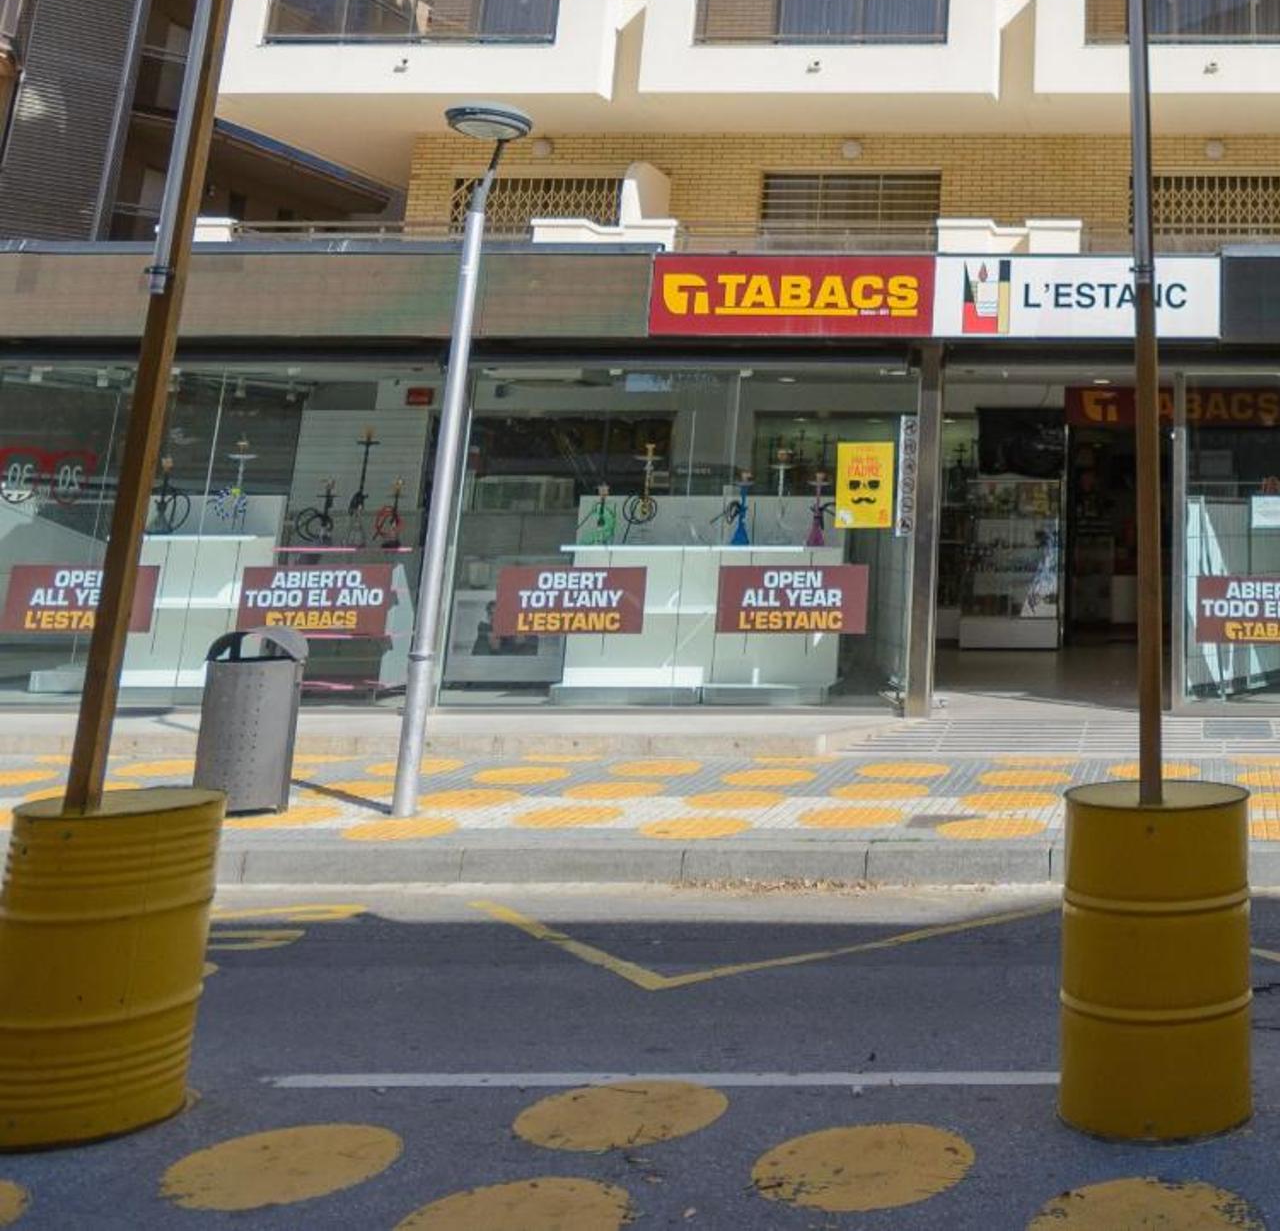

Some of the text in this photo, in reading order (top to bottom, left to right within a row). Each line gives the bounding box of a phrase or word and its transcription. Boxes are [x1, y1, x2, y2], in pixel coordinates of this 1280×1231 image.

[717, 274, 919, 309] TABACS
[1135, 391, 1280, 420] ABACS
[54, 570, 103, 588] OPE
[271, 570, 362, 589] ABIERTO
[538, 572, 608, 589] OBERT
[763, 571, 823, 588] OPEN
[30, 588, 100, 606] ALL YE
[245, 589, 303, 607] TODO
[307, 589, 332, 607] EL
[518, 590, 624, 607] TOT L'ANY
[741, 589, 842, 607] ALL YEAR
[1201, 599, 1260, 617] TODO
[24, 610, 95, 629] L'ESTA
[283, 611, 358, 626] TABACS
[516, 612, 621, 631] L'ESTANC
[738, 611, 843, 629] L'ESTANC
